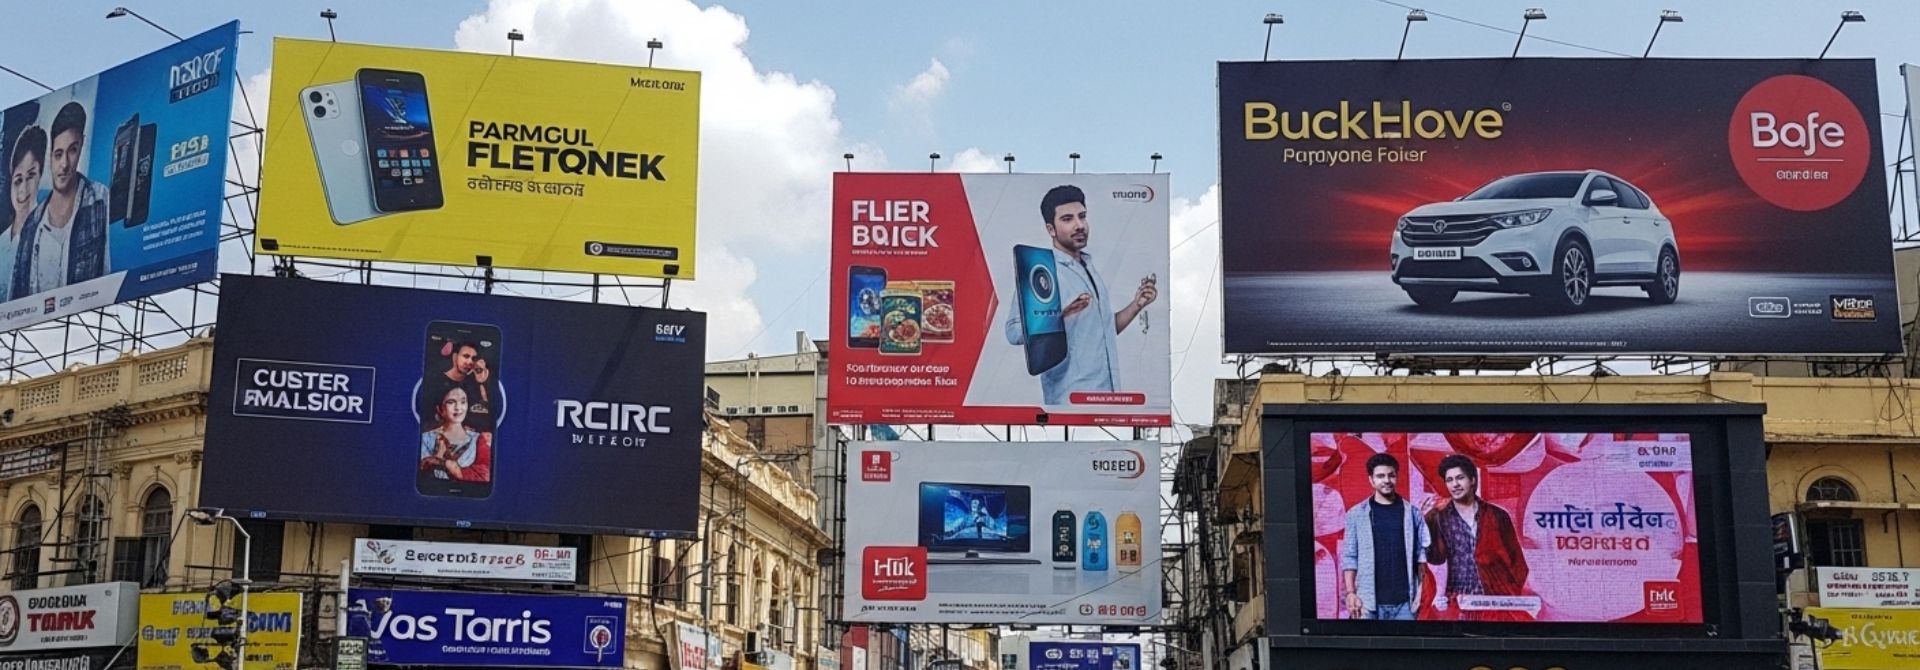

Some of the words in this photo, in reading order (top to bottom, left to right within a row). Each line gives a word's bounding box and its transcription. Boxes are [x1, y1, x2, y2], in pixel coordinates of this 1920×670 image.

[1750, 111, 1845, 156] Bafe
[851, 199, 930, 224] FLIER
[253, 368, 350, 393] CUSTER
[555, 398, 672, 434] RCIRC
